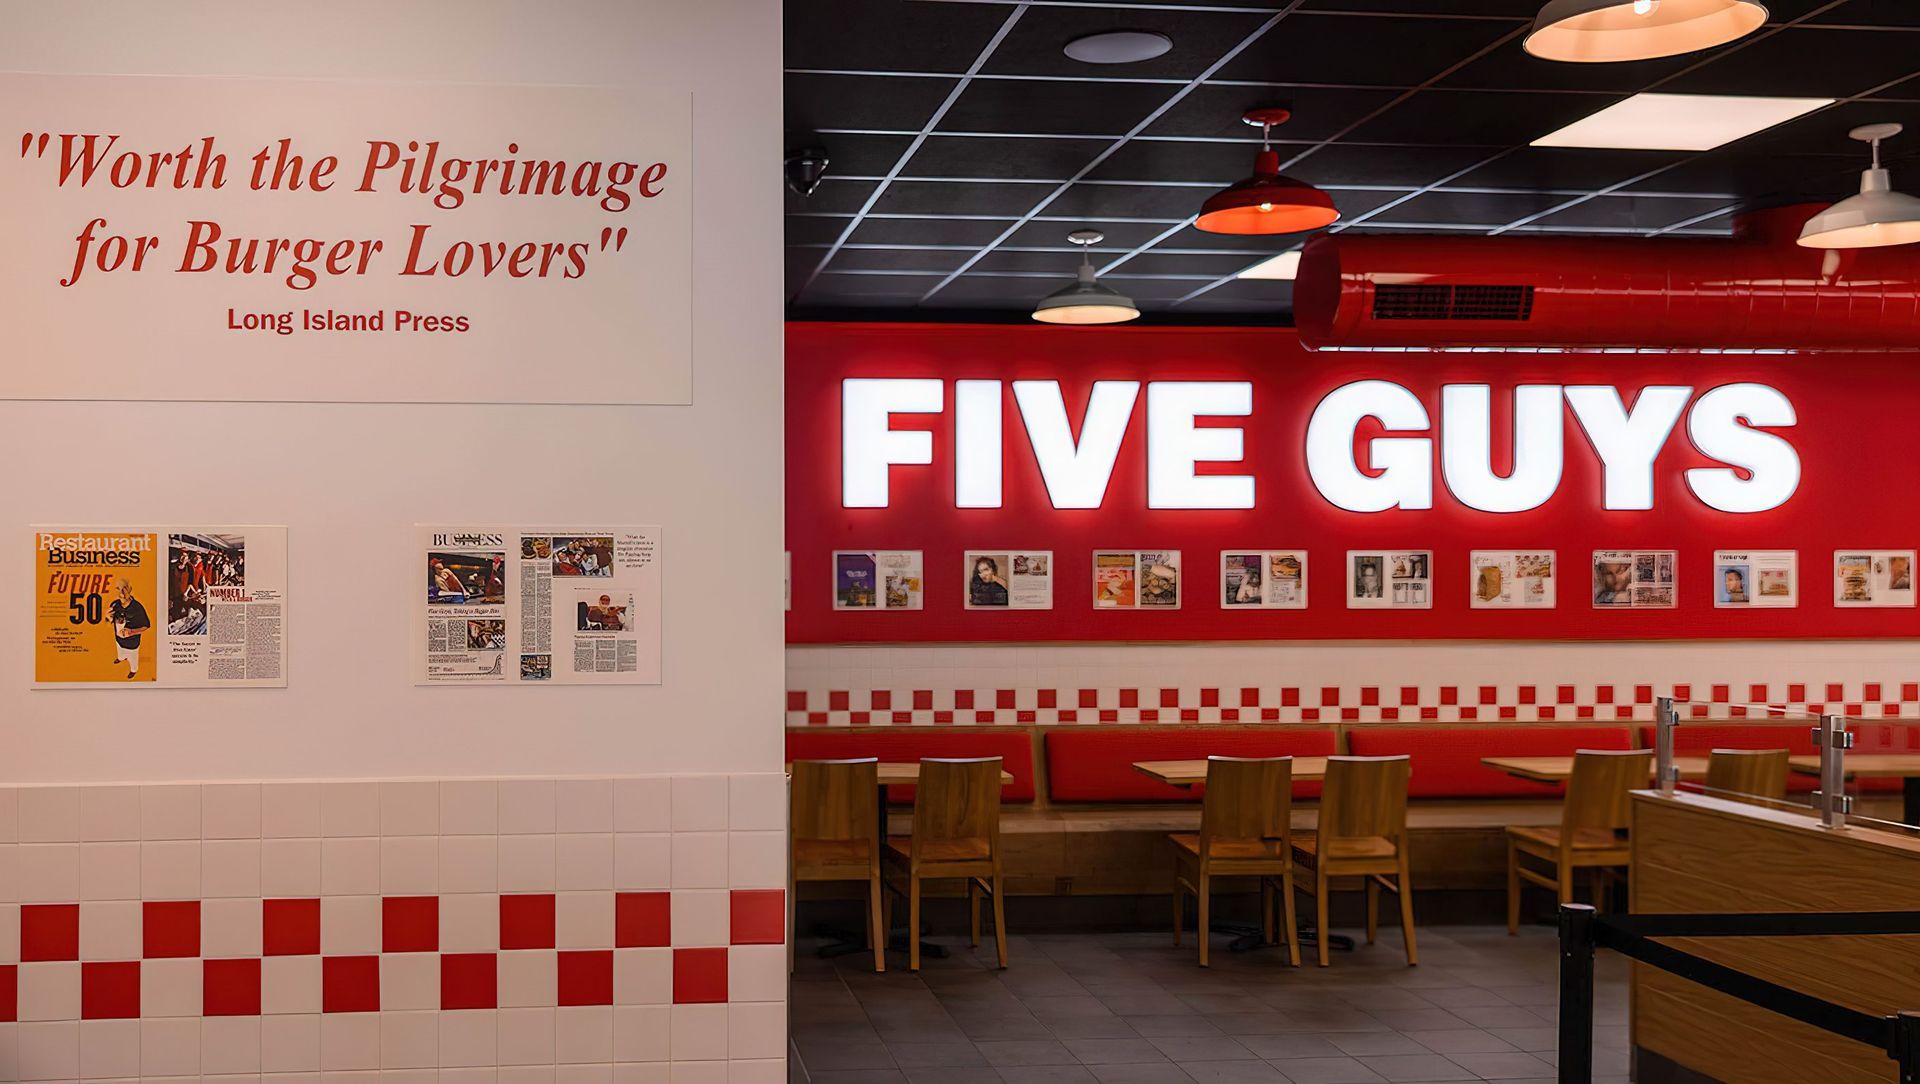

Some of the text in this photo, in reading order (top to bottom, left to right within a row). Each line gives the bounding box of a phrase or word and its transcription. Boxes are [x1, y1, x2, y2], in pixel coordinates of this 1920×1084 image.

[21, 132, 668, 213] "Worth the Pilgrimage
[60, 218, 628, 291] for Burger Lovers"
[227, 307, 470, 335] Long Island Press
[842, 378, 1802, 513] FIVE GUYS
[39, 532, 151, 551] Restaurant
[433, 533, 503, 546] BUSINESS
[48, 547, 141, 565] Business
[47, 573, 113, 594] FUTURE
[69, 593, 103, 625] 50
